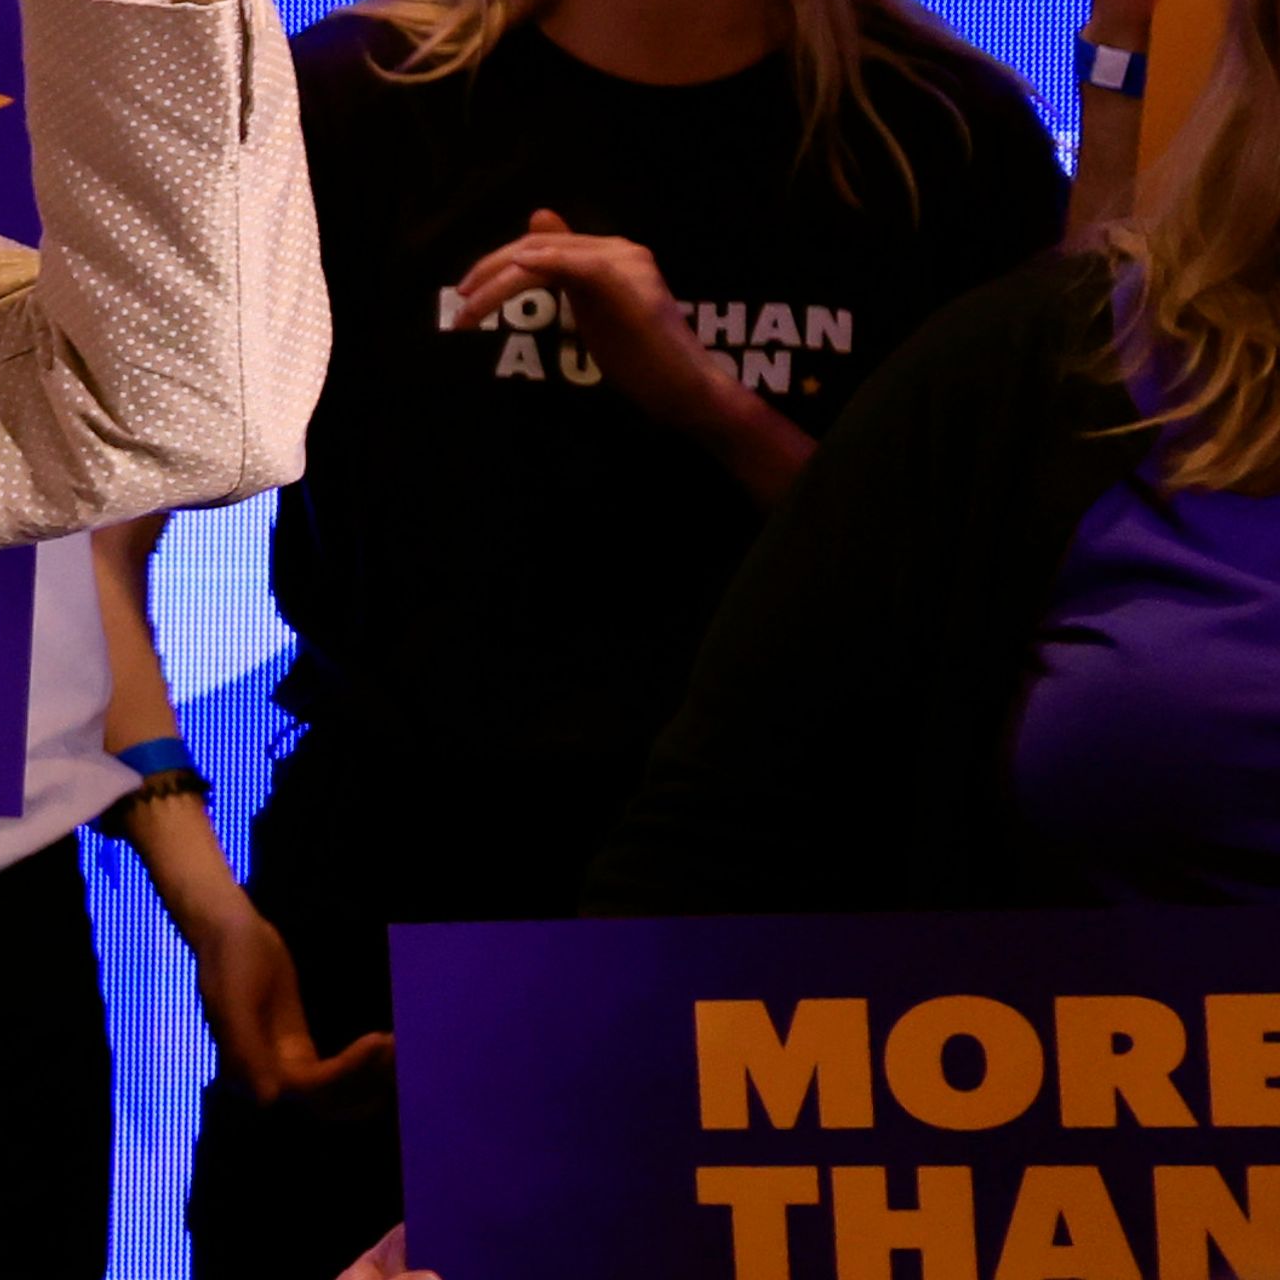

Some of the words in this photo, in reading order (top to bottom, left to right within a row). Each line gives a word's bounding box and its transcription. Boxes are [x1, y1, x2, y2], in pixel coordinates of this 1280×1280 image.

[495, 333, 546, 381] A
[677, 301, 853, 353] HAN
[694, 993, 1280, 1131] MORE
[695, 1165, 1280, 1280] THAN
